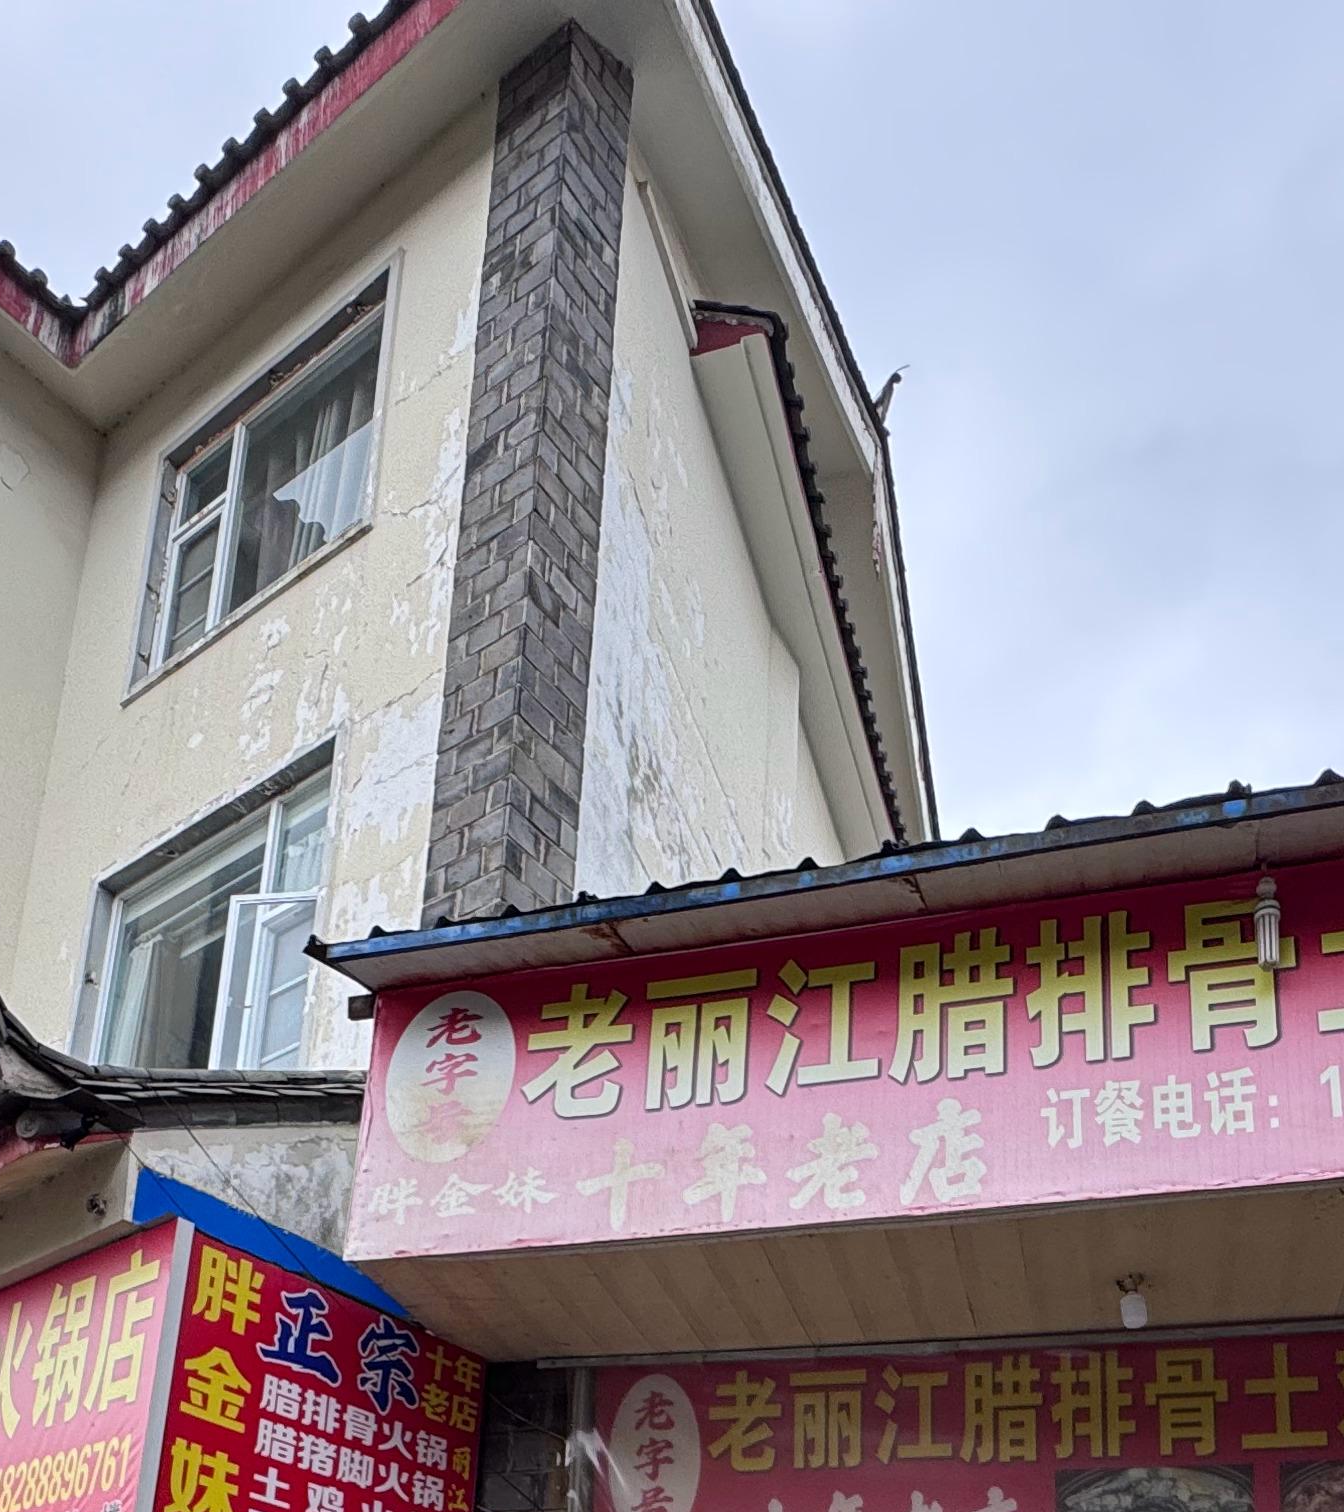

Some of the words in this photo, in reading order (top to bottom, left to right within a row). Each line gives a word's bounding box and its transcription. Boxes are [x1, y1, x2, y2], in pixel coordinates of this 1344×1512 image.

[367, 1167, 558, 1226] 胖金妹
[576, 1096, 993, 1231] 十年老店
[257, 1288, 420, 1415] 正宗
[254, 1421, 446, 1512] 腊猪脚火锅
[259, 1375, 448, 1473] 腊排骨火锅
